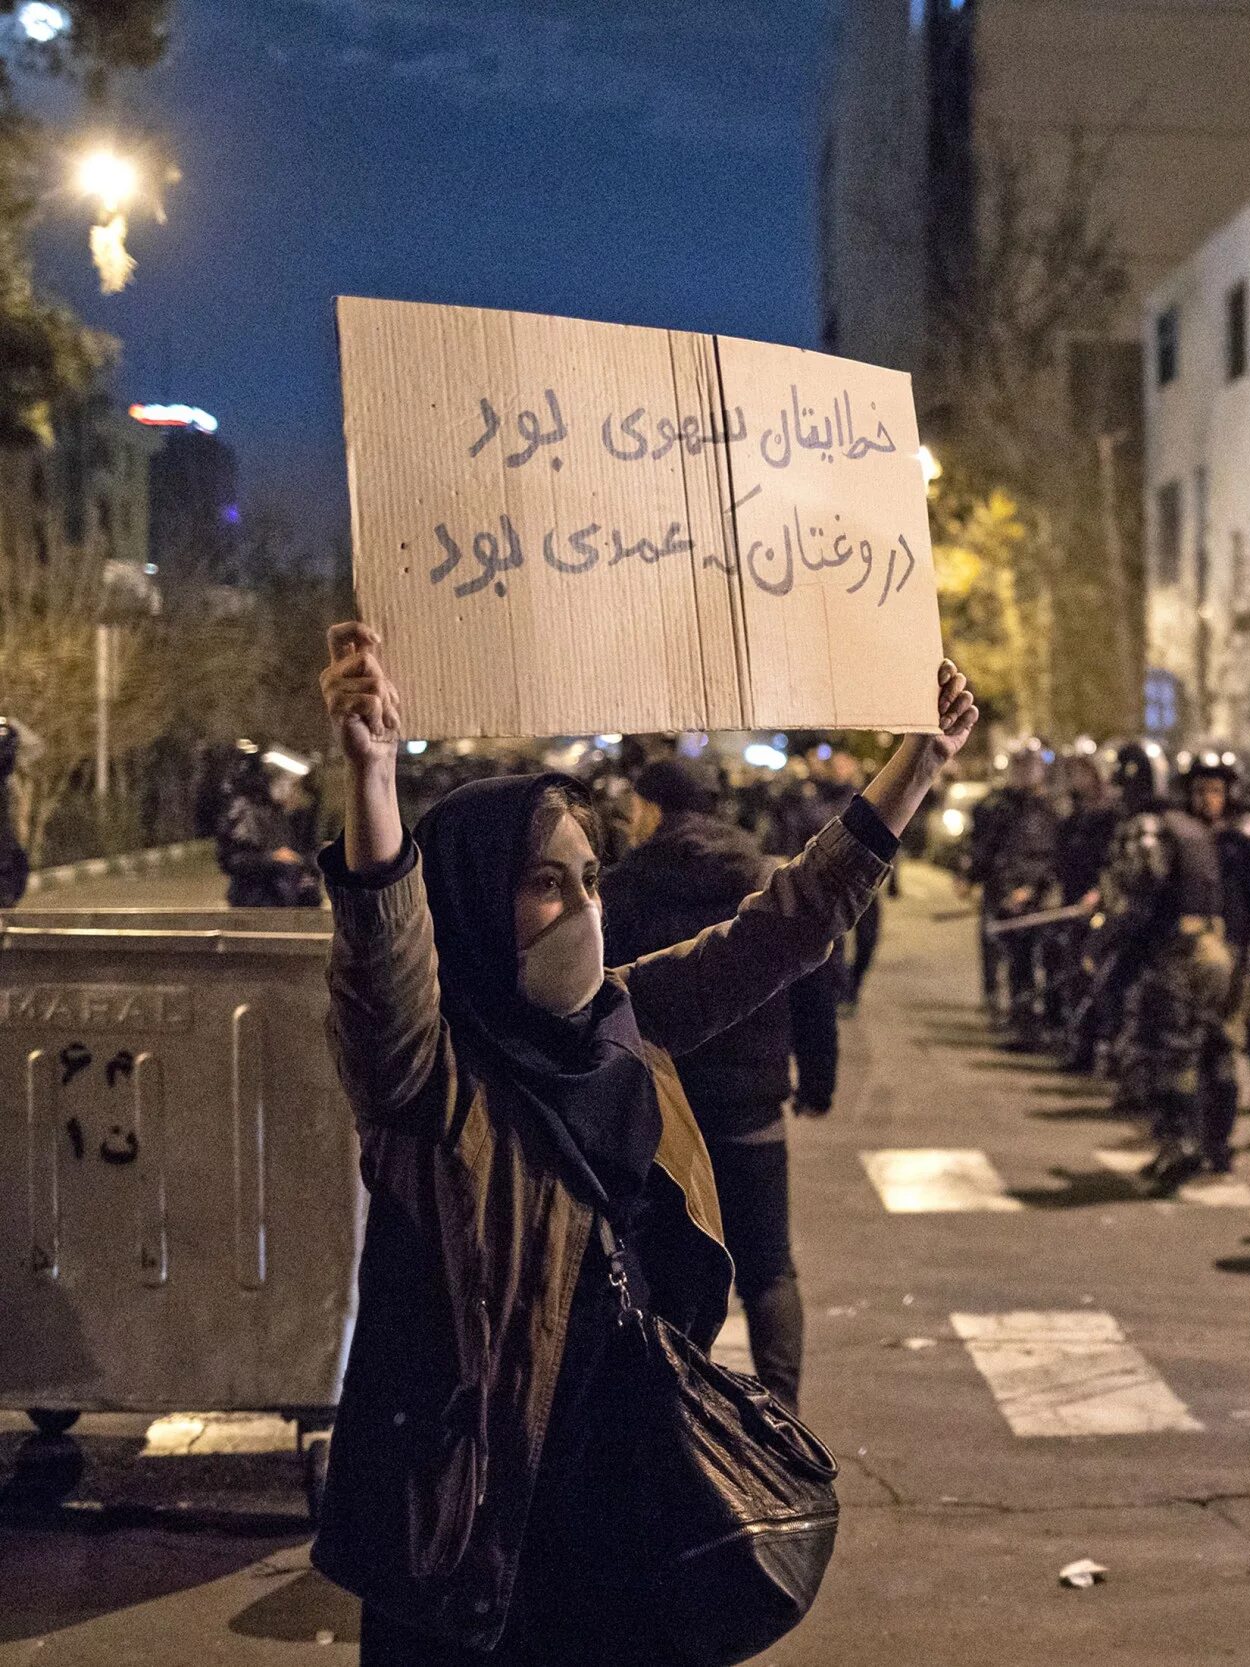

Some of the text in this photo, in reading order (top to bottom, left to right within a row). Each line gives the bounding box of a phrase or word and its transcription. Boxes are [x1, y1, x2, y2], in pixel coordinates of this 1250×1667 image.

[469, 388, 567, 472] بود
[601, 406, 747, 461] سهوی
[430, 484, 915, 607] دروغتان که عمدی بود
